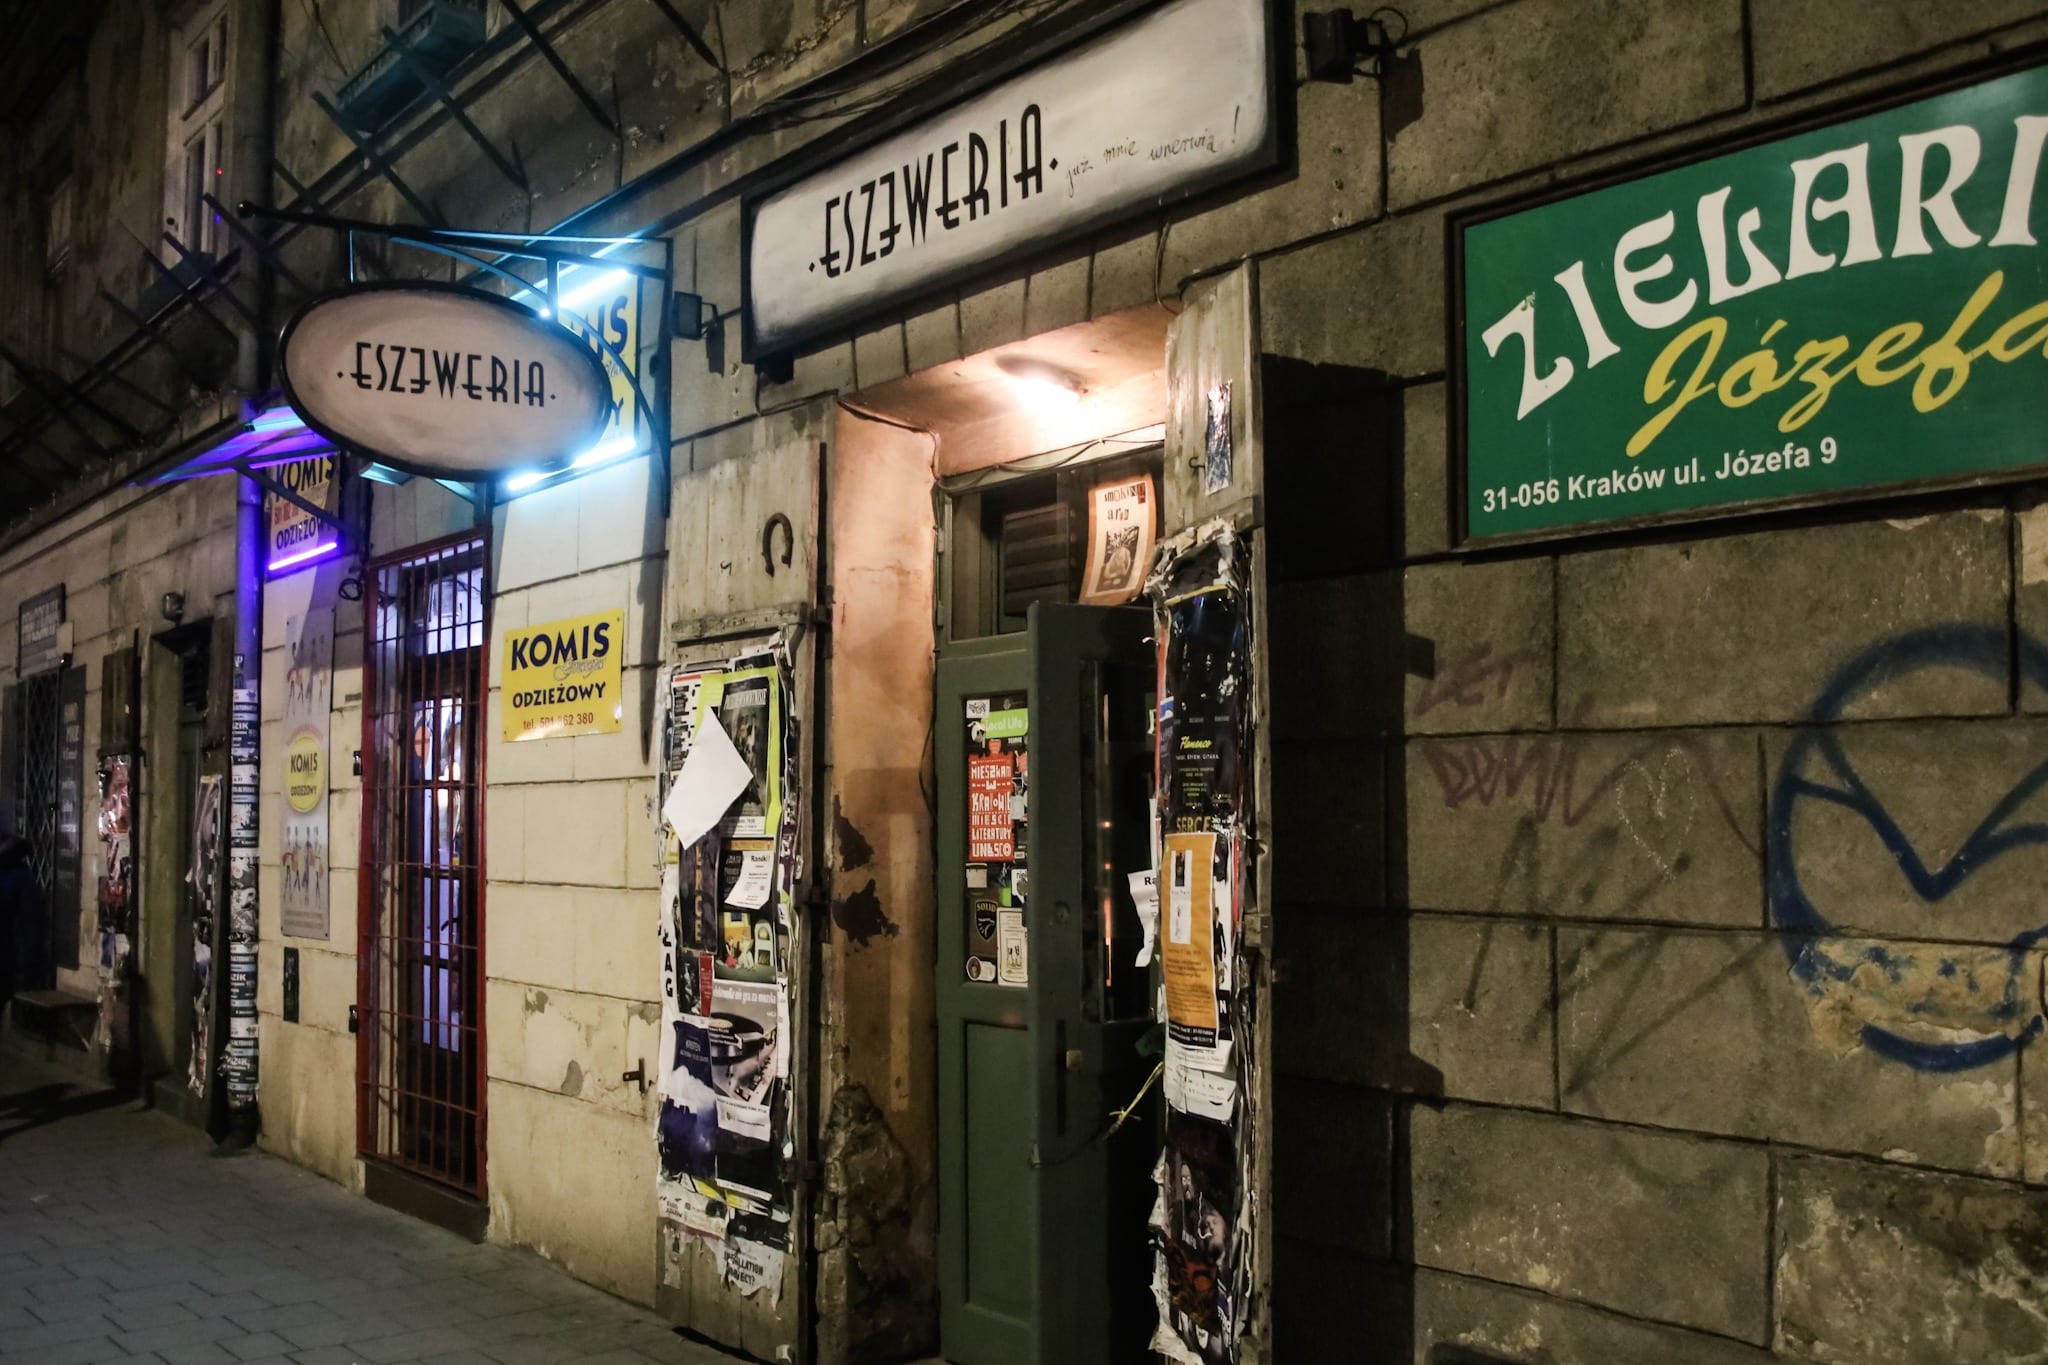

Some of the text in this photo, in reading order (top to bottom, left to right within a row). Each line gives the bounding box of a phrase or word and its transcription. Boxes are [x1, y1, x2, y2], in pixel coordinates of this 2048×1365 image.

[1103, 136, 1139, 163] mnie
[1482, 436, 1838, 513] 31-056 Kraków ul. Józefa 9
[511, 621, 611, 672] KOMIS
[512, 681, 607, 709] ODZIEŻOWY
[576, 711, 594, 726] 380
[290, 752, 318, 774] KOMIS
